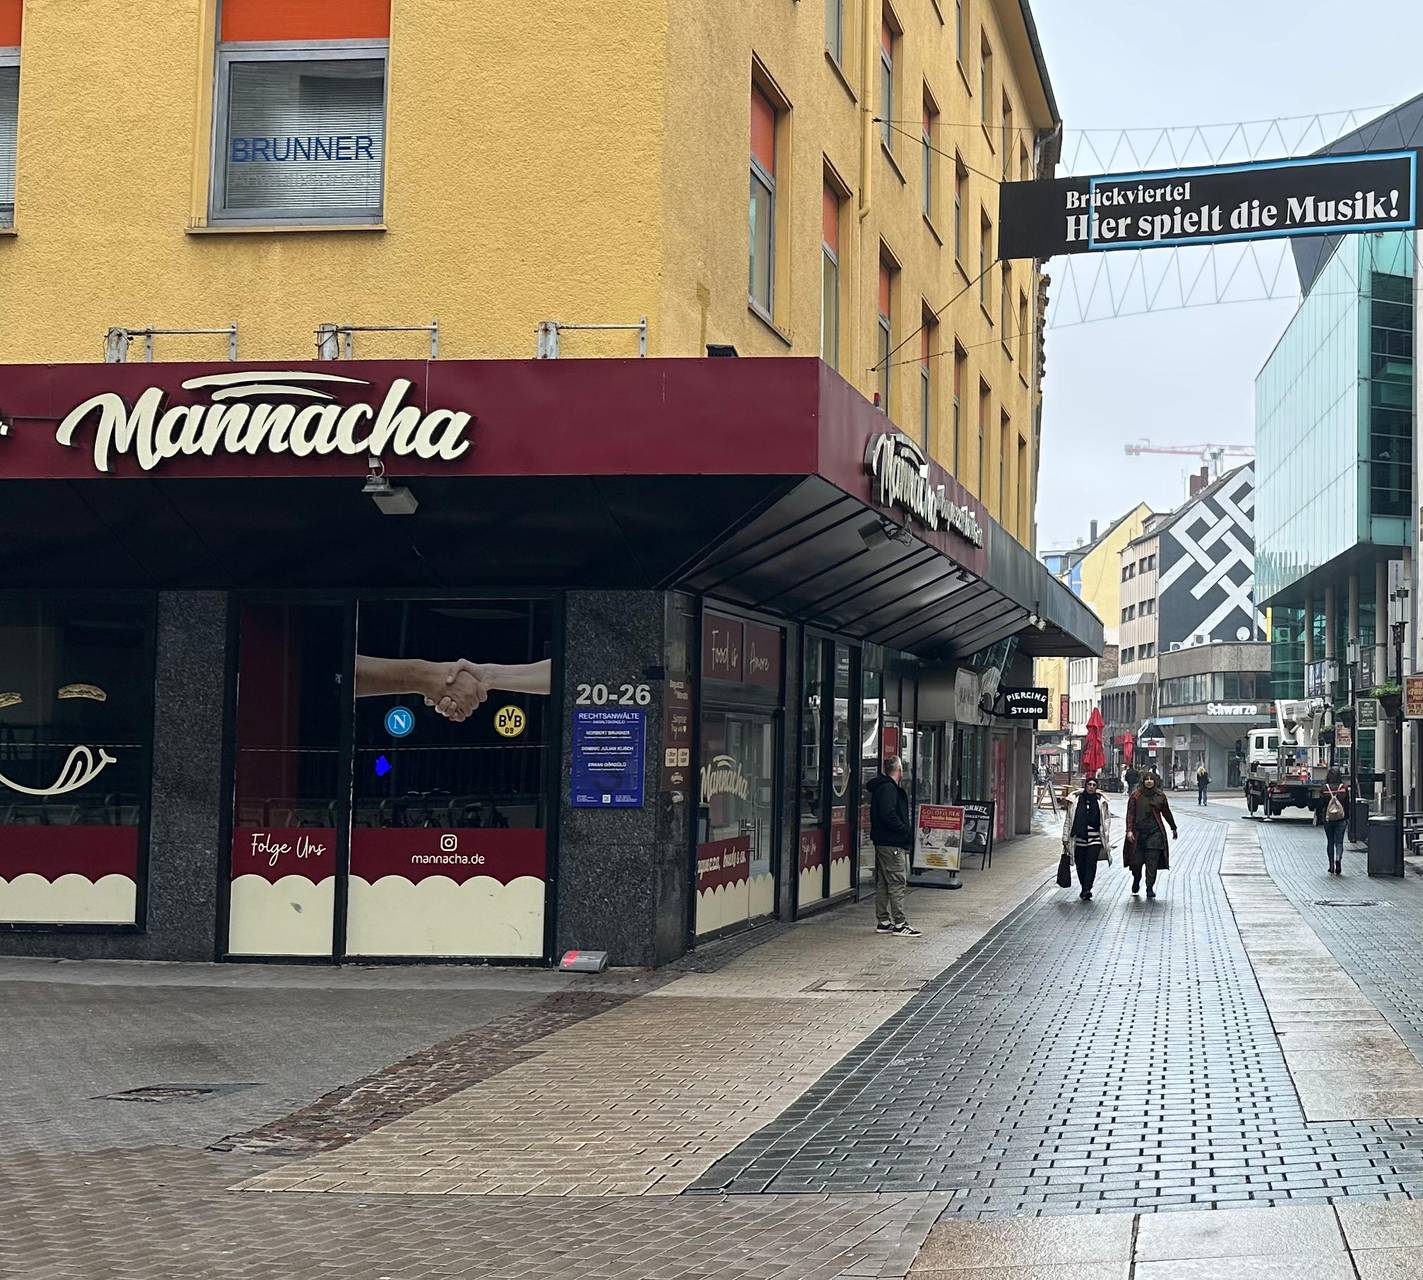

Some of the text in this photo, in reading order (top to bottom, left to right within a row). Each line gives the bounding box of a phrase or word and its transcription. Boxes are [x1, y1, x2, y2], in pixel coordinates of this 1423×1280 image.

[231, 136, 374, 162] BRUNNER
[1066, 182, 1191, 209] Brückviertel
[1065, 189, 1399, 242] Hier spielt die Musik!
[56, 376, 474, 472] Mannacha
[576, 684, 651, 705] 20-26
[1006, 691, 1047, 703] PIERCING
[499, 709, 522, 728] BVB
[578, 712, 640, 720] RECHTSANWÄLTE
[1010, 706, 1043, 715] STUDIO
[1207, 703, 1257, 716] Schwarze
[393, 714, 407, 730] N
[251, 833, 327, 866] Folge Uns
[411, 853, 485, 864] mannacha.de
